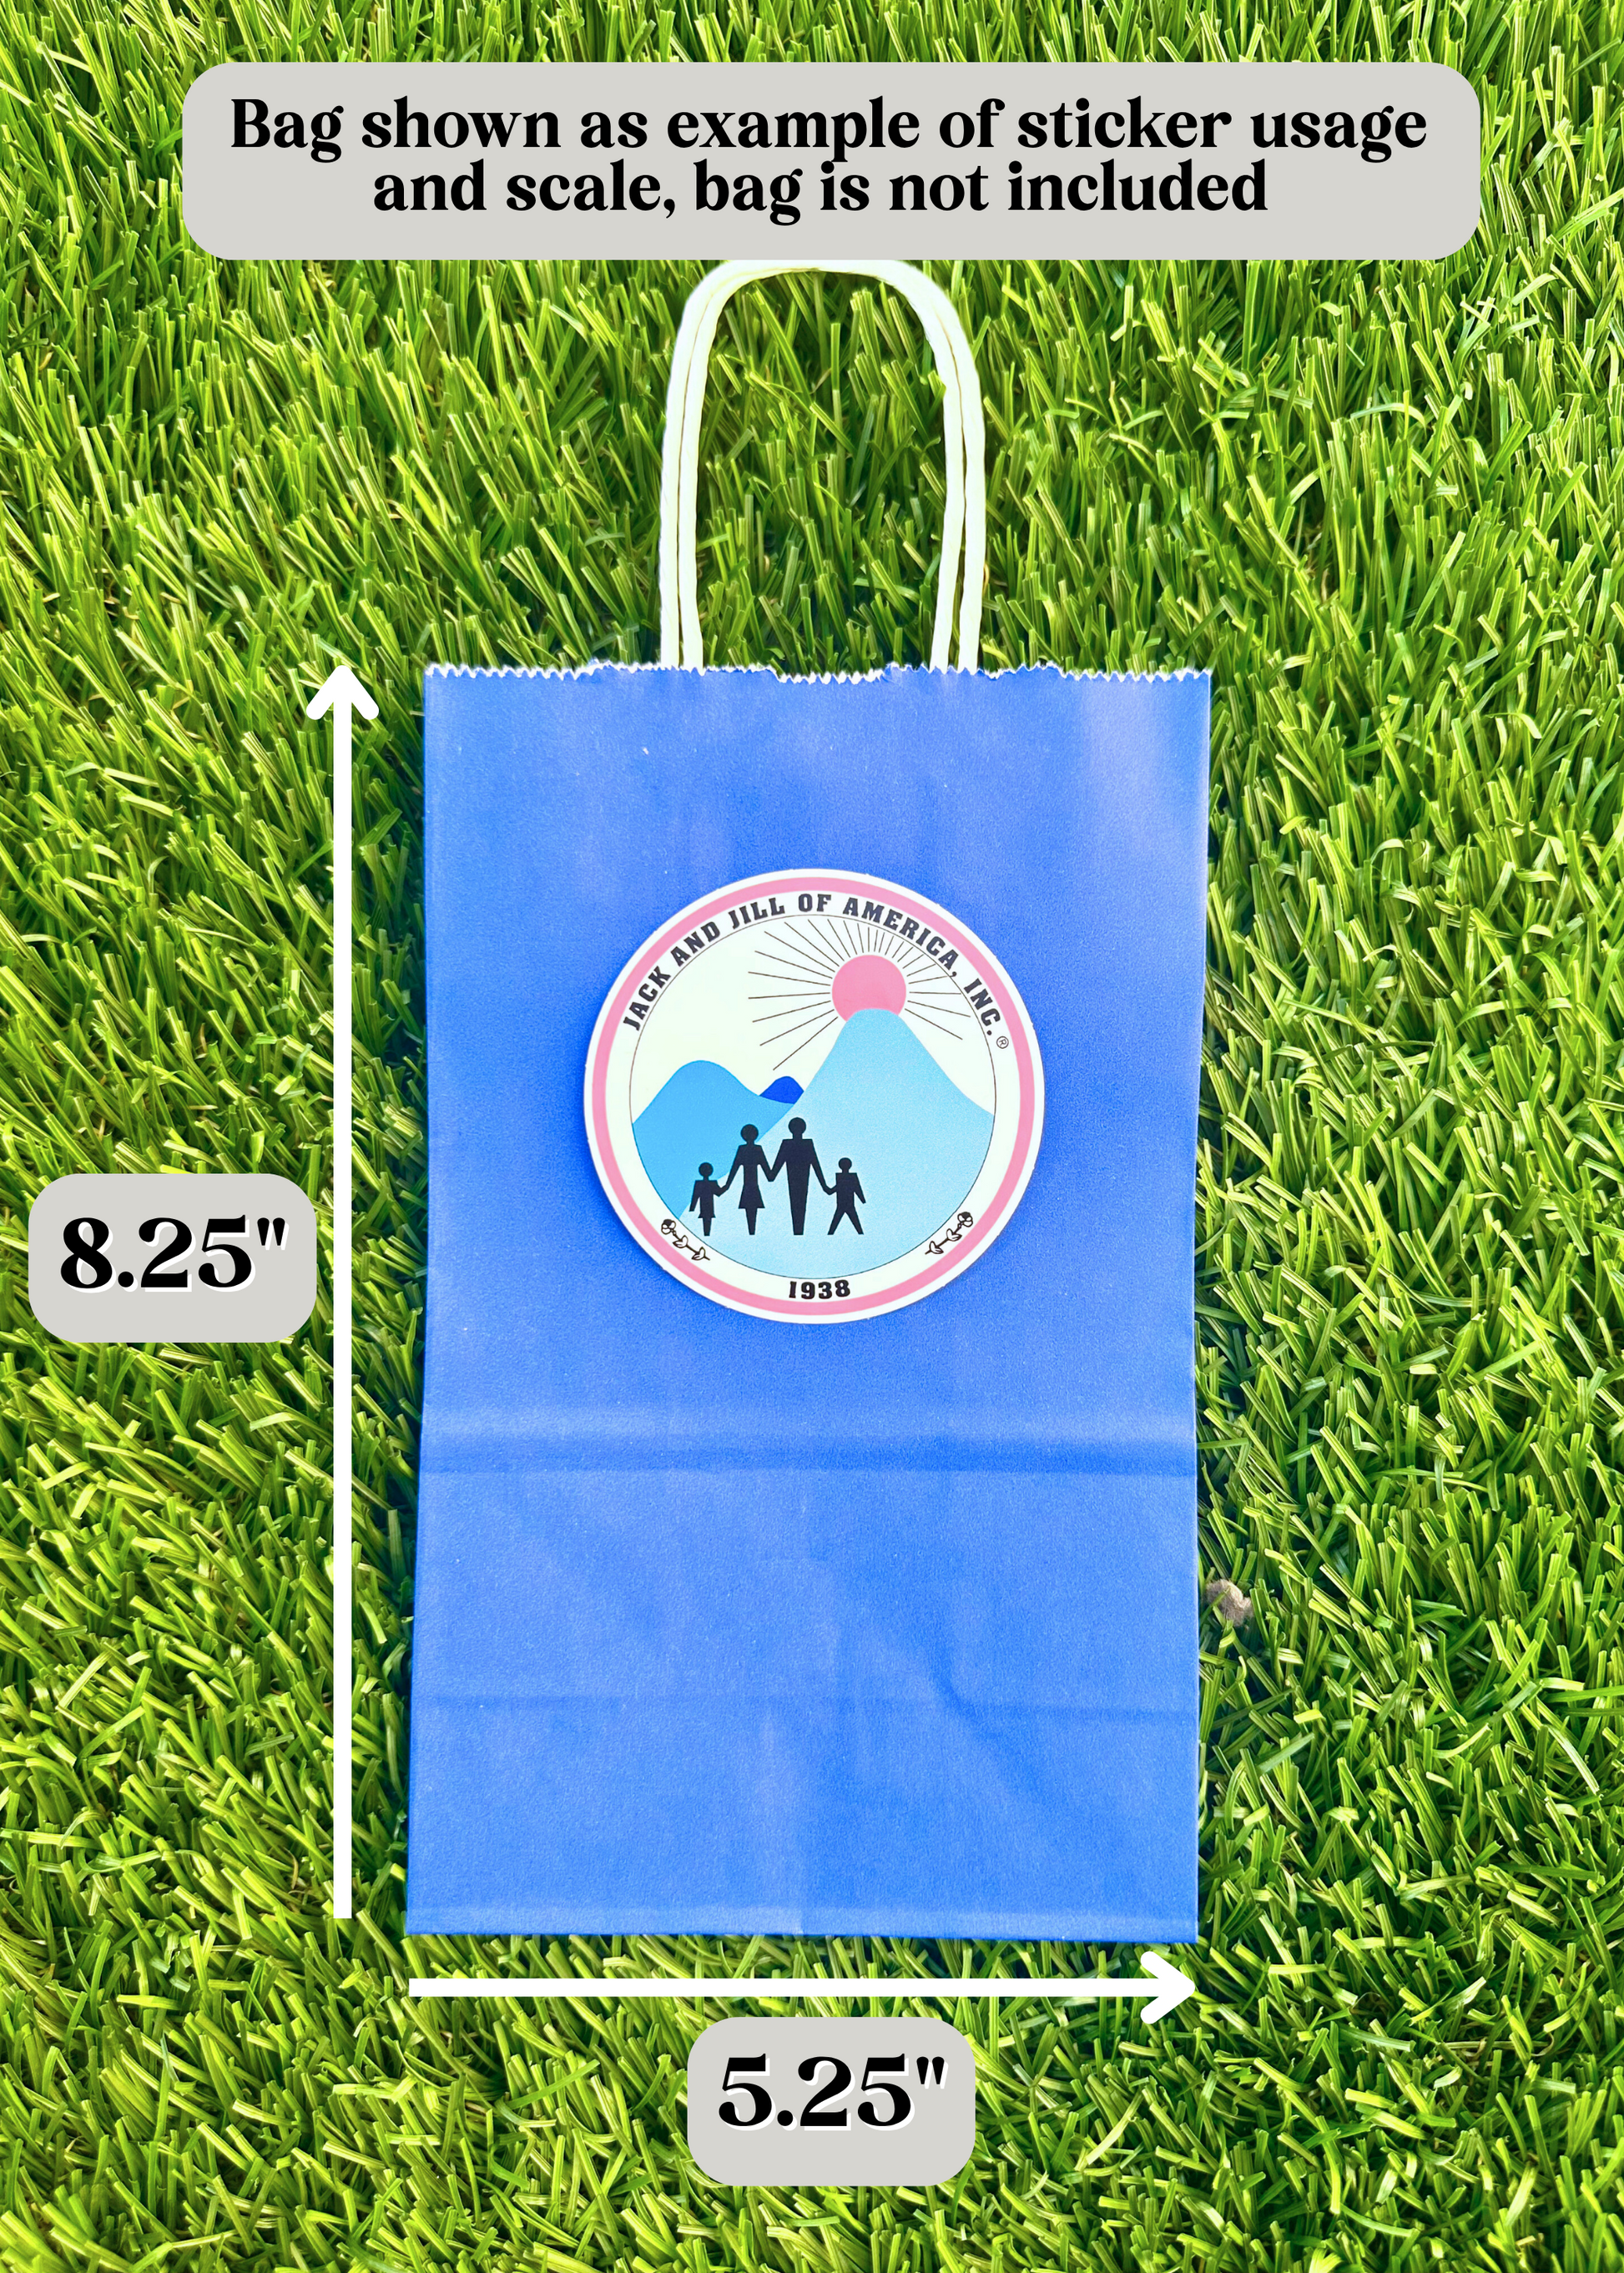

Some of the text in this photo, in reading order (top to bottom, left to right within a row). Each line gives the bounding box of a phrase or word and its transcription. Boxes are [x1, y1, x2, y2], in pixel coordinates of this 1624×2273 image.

[622, 965, 671, 1031] JACK
[670, 921, 720, 967] AND
[728, 897, 785, 930] JILL
[798, 893, 831, 912] OF
[842, 897, 959, 977] AMERICA,
[963, 977, 1001, 1036] INC.
[789, 1279, 850, 1300] 1938
